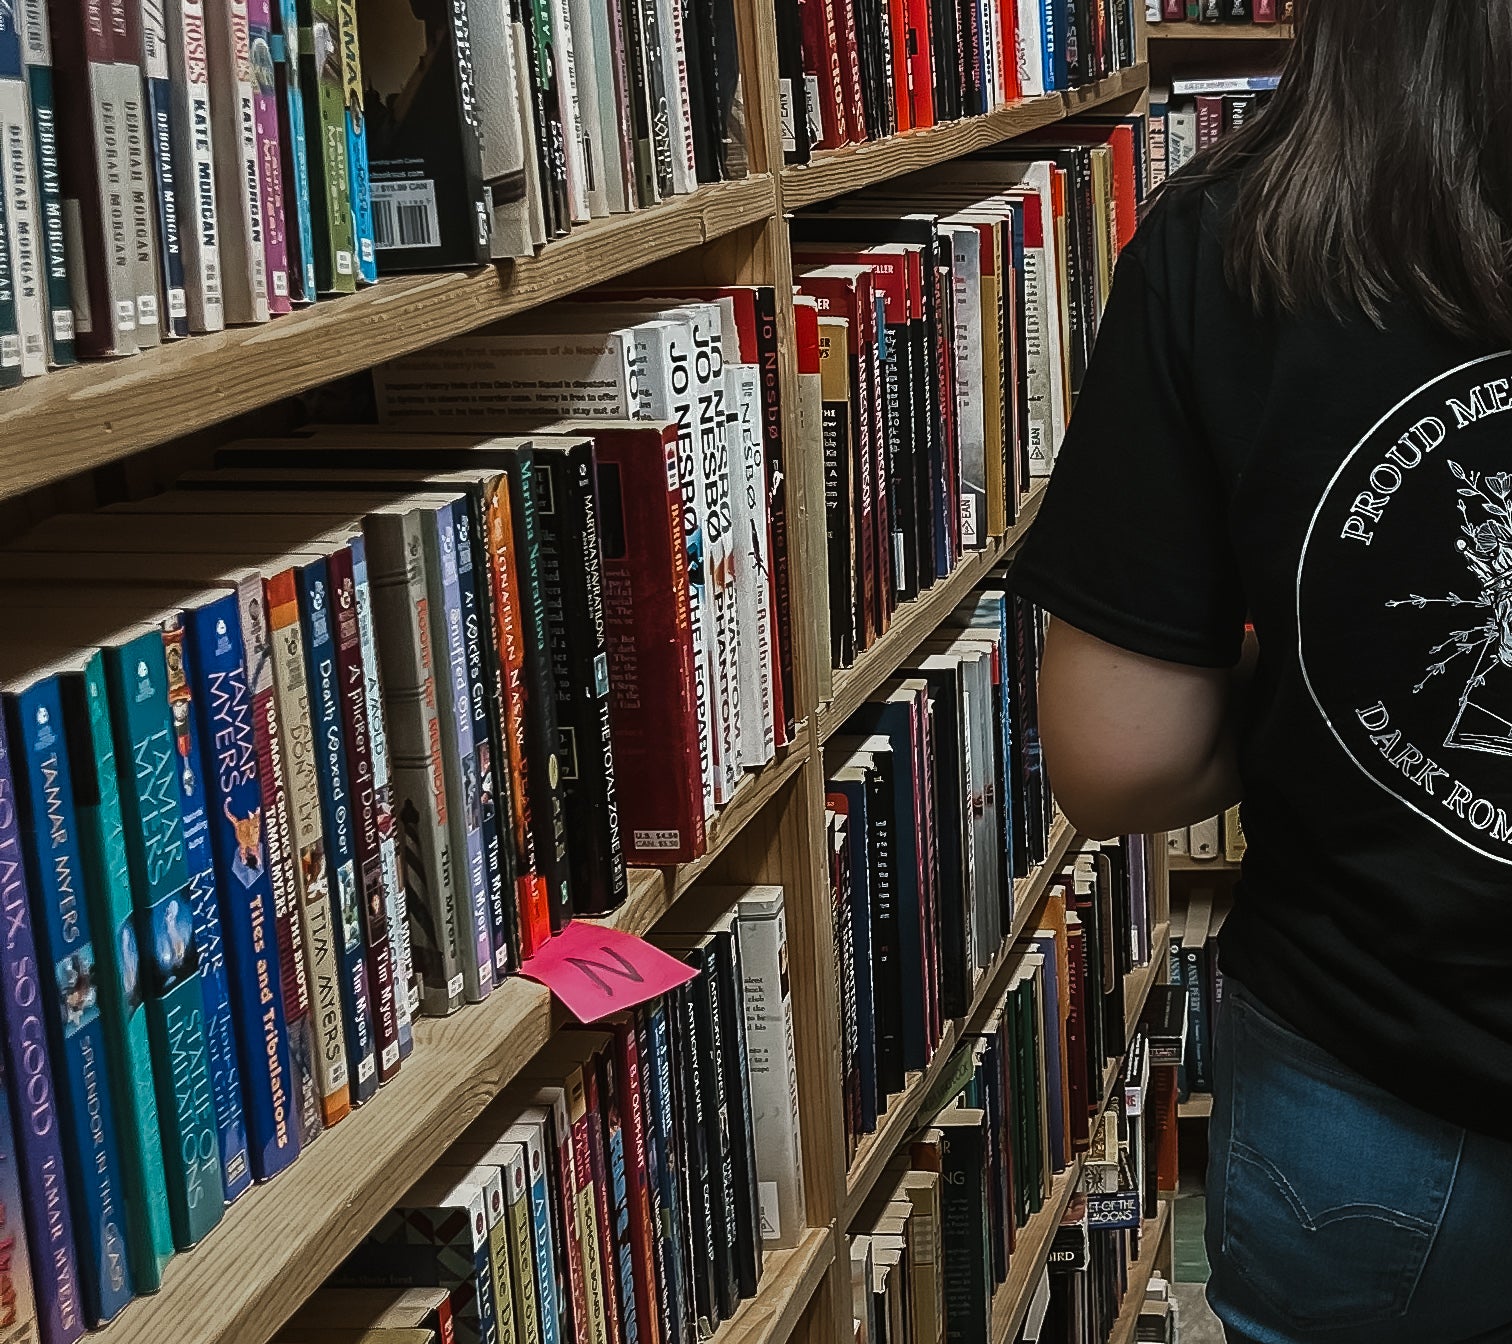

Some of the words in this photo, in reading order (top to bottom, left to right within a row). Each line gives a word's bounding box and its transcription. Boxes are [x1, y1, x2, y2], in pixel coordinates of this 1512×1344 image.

[186, 15, 207, 84] ROSES
[38, 108, 59, 193] DEBORAH
[157, 113, 173, 183] DEBORAH
[194, 99, 209, 150] KATE
[164, 190, 179, 254] MORGAN
[198, 161, 216, 247] MORGAN
[46, 202, 65, 278] MORGAN
[669, 342, 690, 403] JO
[692, 324, 712, 384] JO
[674, 408, 699, 536] NESBØ
[697, 397, 722, 543] NESBØ
[1340, 416, 1446, 546] PROUD
[320, 659, 337, 721] Death
[714, 591, 732, 733] PHANTOM
[207, 671, 239, 793] MYERS
[228, 668, 256, 786] TAMAR
[264, 697, 279, 733] TOO
[1355, 700, 1448, 794] DARK
[269, 737, 283, 785] MANY
[326, 725, 344, 800] Waxed
[133, 736, 165, 886] MYERS
[152, 729, 183, 862] TAMAR
[274, 789, 292, 857] CROOKS
[266, 807, 281, 862] TAMAR
[337, 805, 349, 855] Over
[272, 865, 288, 918] MYERS
[281, 861, 297, 908] SPOIL
[250, 894, 267, 951] Tiles
[286, 912, 301, 948] THE
[312, 907, 330, 965] TIM
[12, 956, 37, 1006] SO
[256, 960, 274, 1001] and
[292, 951, 308, 1010] BROTH
[351, 959, 366, 999] Tim
[566, 946, 646, 998] N
[318, 974, 341, 1061] MYERS
[354, 1002, 370, 1046] Myers
[21, 1017, 51, 1135] GOOD
[185, 1009, 210, 1123] STATUE
[260, 1008, 289, 1148] Tribulations
[167, 1004, 203, 1209] LIMITATIONS
[199, 1129, 218, 1174] OF
[42, 1157, 63, 1239] TAMAR
[54, 1248, 75, 1329] MYERS
